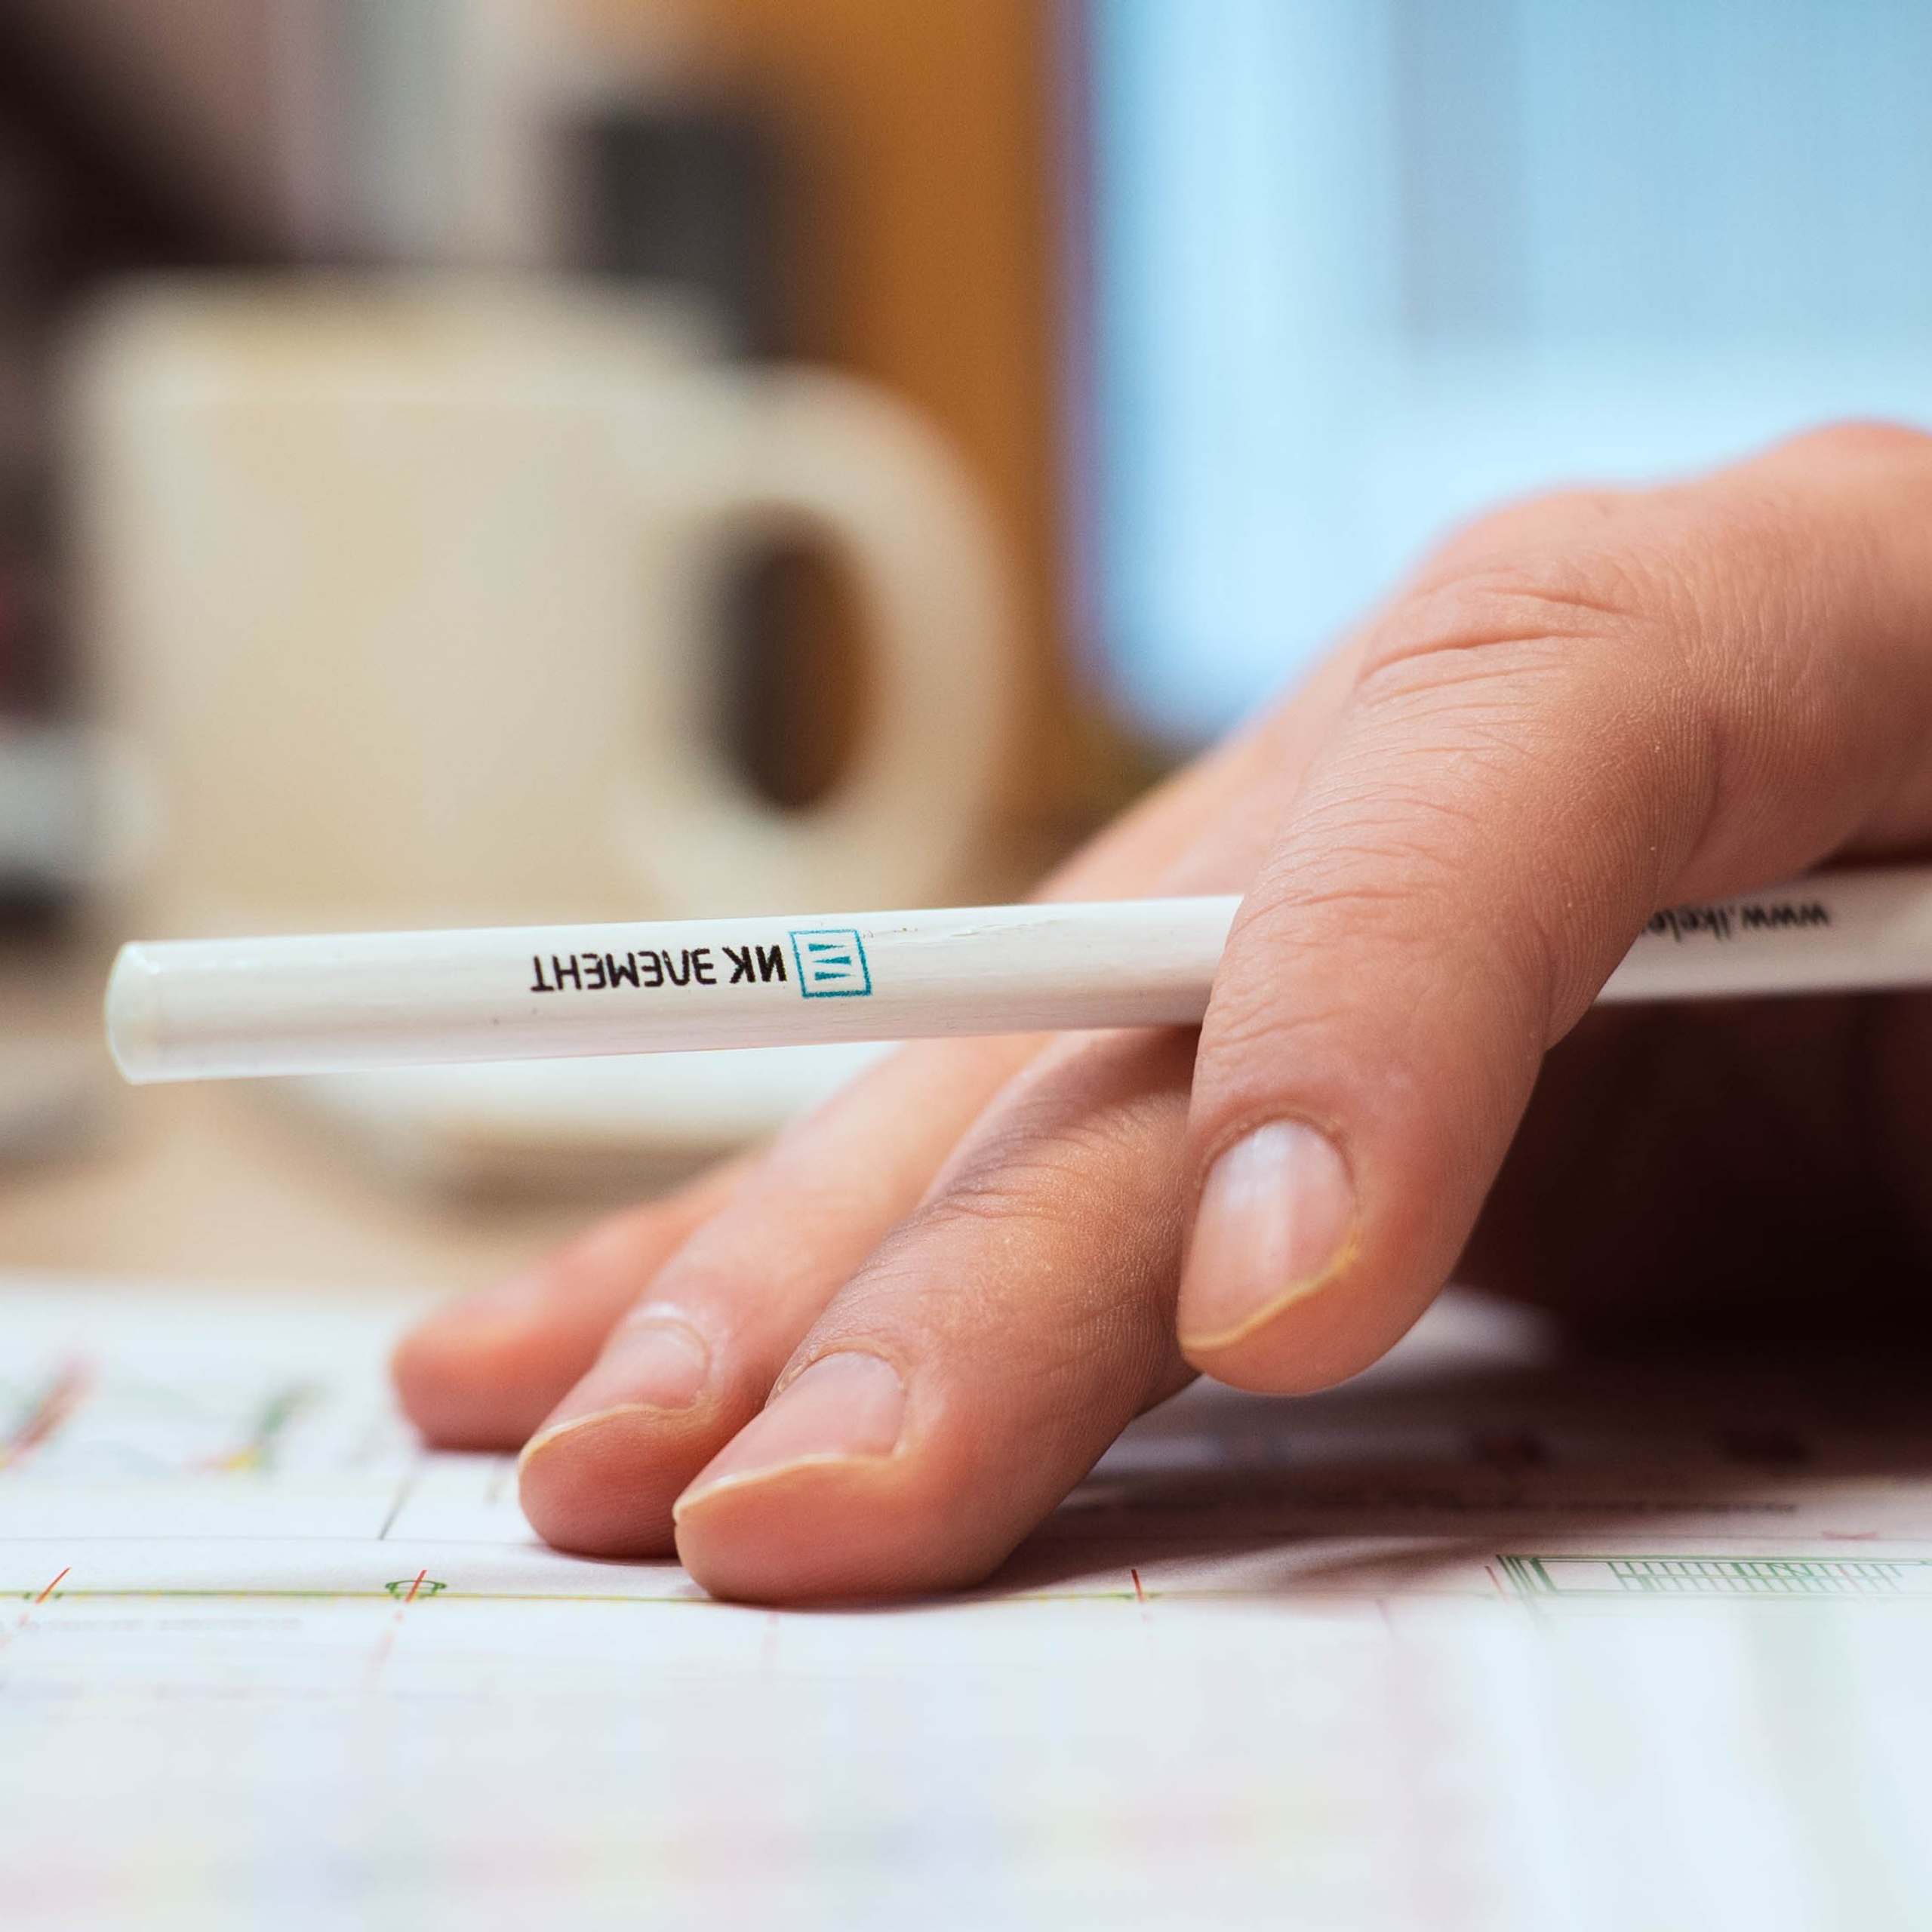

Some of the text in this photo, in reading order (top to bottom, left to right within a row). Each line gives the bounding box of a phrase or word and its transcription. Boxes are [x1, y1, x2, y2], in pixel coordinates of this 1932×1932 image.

[1641, 904, 1829, 943] www.ikele
[531, 945, 787, 992] ИК ЭЛЕМЕНТ
